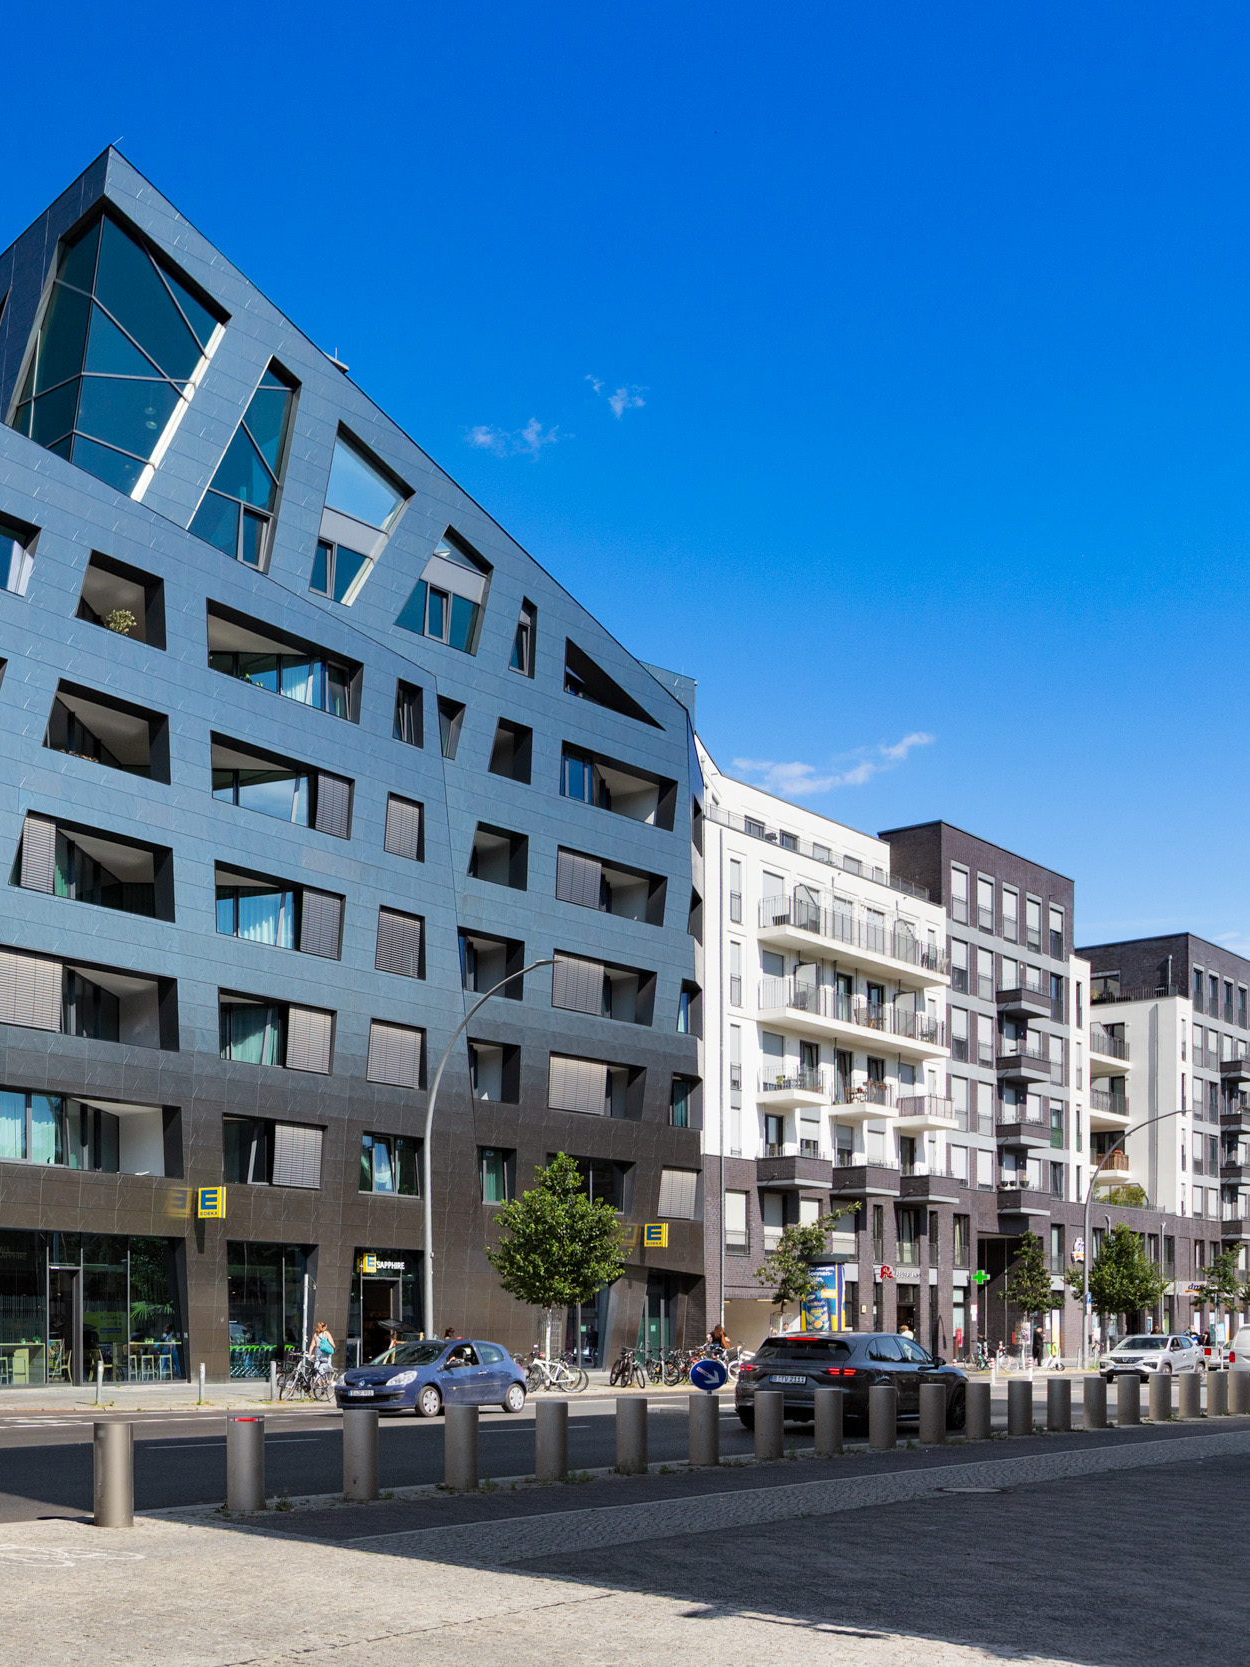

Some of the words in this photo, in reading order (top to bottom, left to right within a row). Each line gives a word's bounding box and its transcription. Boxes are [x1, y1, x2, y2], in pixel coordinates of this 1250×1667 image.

[201, 1190, 217, 1210] E
[647, 1226, 662, 1240] E
[376, 1260, 405, 1270] SAPPHIRE
